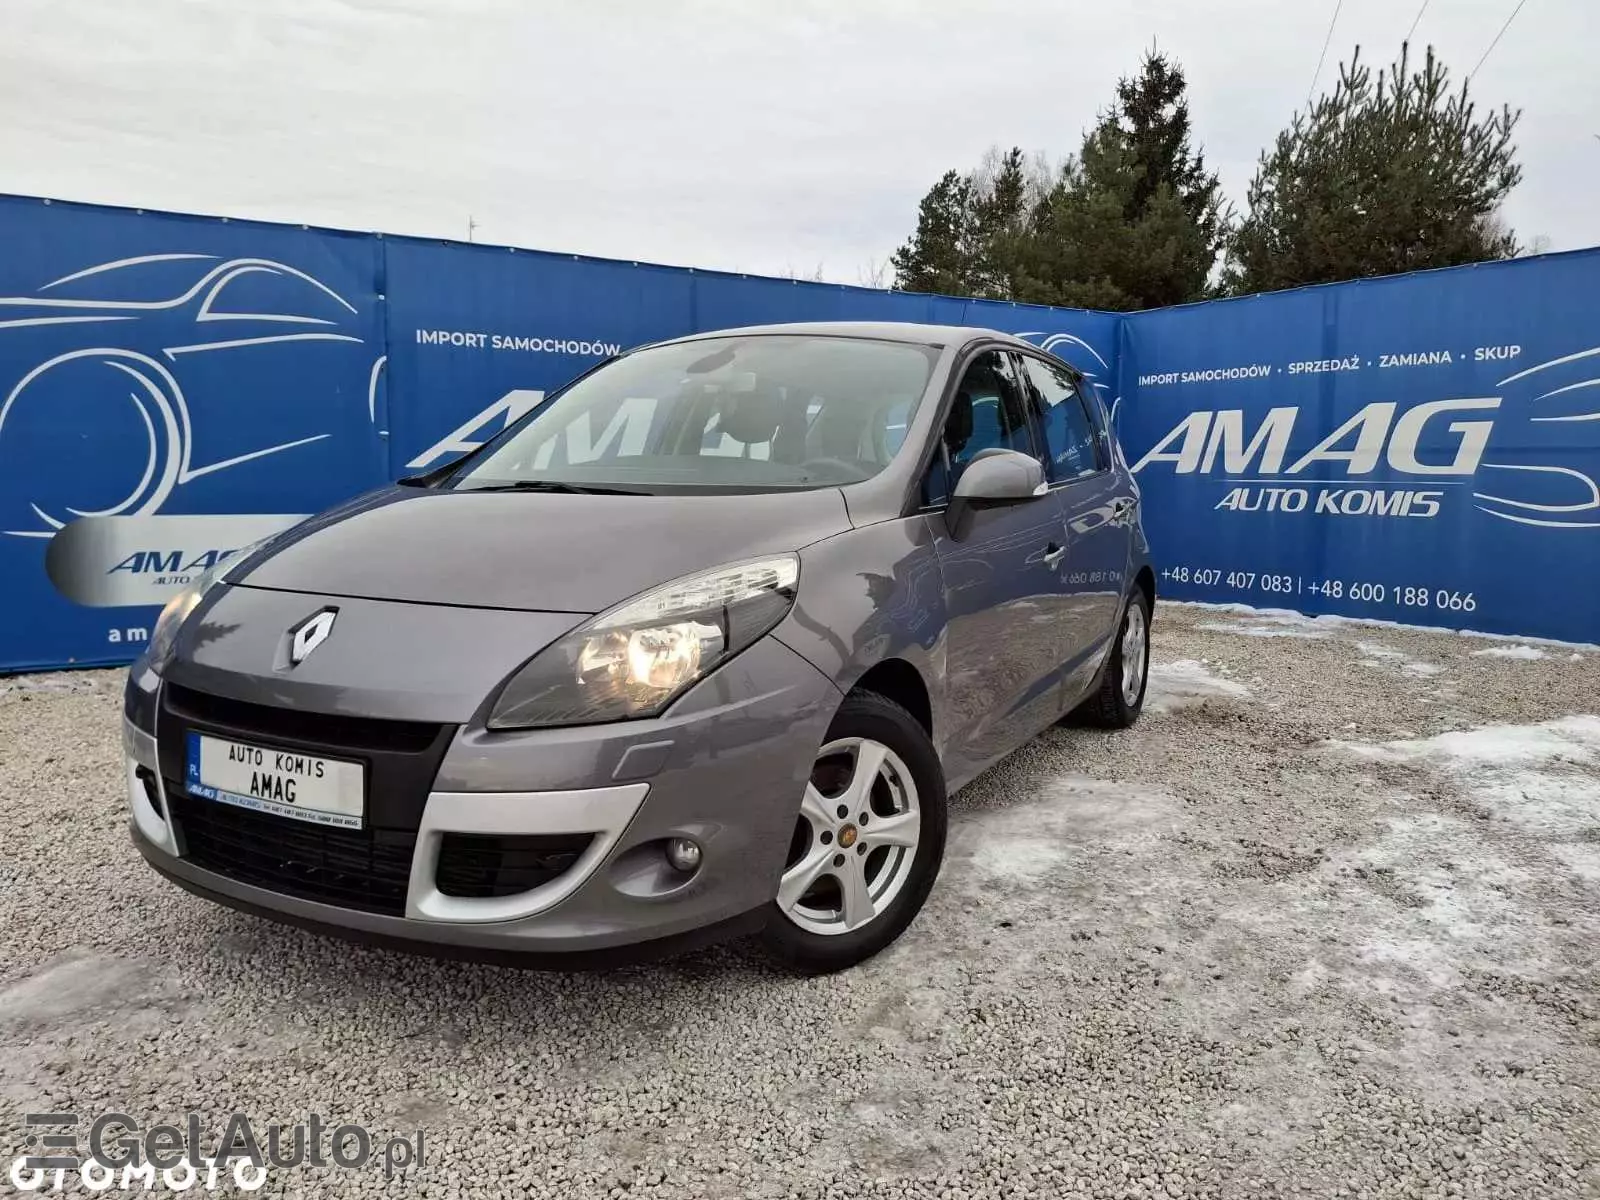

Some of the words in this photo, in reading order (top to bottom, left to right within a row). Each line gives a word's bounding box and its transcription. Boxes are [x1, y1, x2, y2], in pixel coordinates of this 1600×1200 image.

[415, 329, 488, 348] IMPORT
[491, 335, 621, 357] SAMOCHODÓW
[1138, 371, 1180, 388] IMPORT
[1181, 364, 1272, 384] SAMOCHODÓW
[1287, 354, 1360, 375] SPRZEDAŻ
[1379, 349, 1453, 368] ZAMIANA
[1473, 344, 1522, 362] SKUP
[1213, 487, 1308, 513] AUTO
[1314, 489, 1444, 518] KOMIS
[152, 576, 191, 586] AUTO
[1161, 566, 1190, 583] +48
[1192, 569, 1222, 586] 607
[1226, 571, 1256, 590] 407
[1260, 574, 1293, 594] 083
[1307, 579, 1343, 599] +48
[1349, 582, 1386, 603] 600
[1393, 585, 1429, 607] 188
[1435, 590, 1477, 612] 066
[228, 744, 264, 767] AUTO
[275, 752, 325, 779] KOMIS
[249, 771, 297, 804] AMAG
